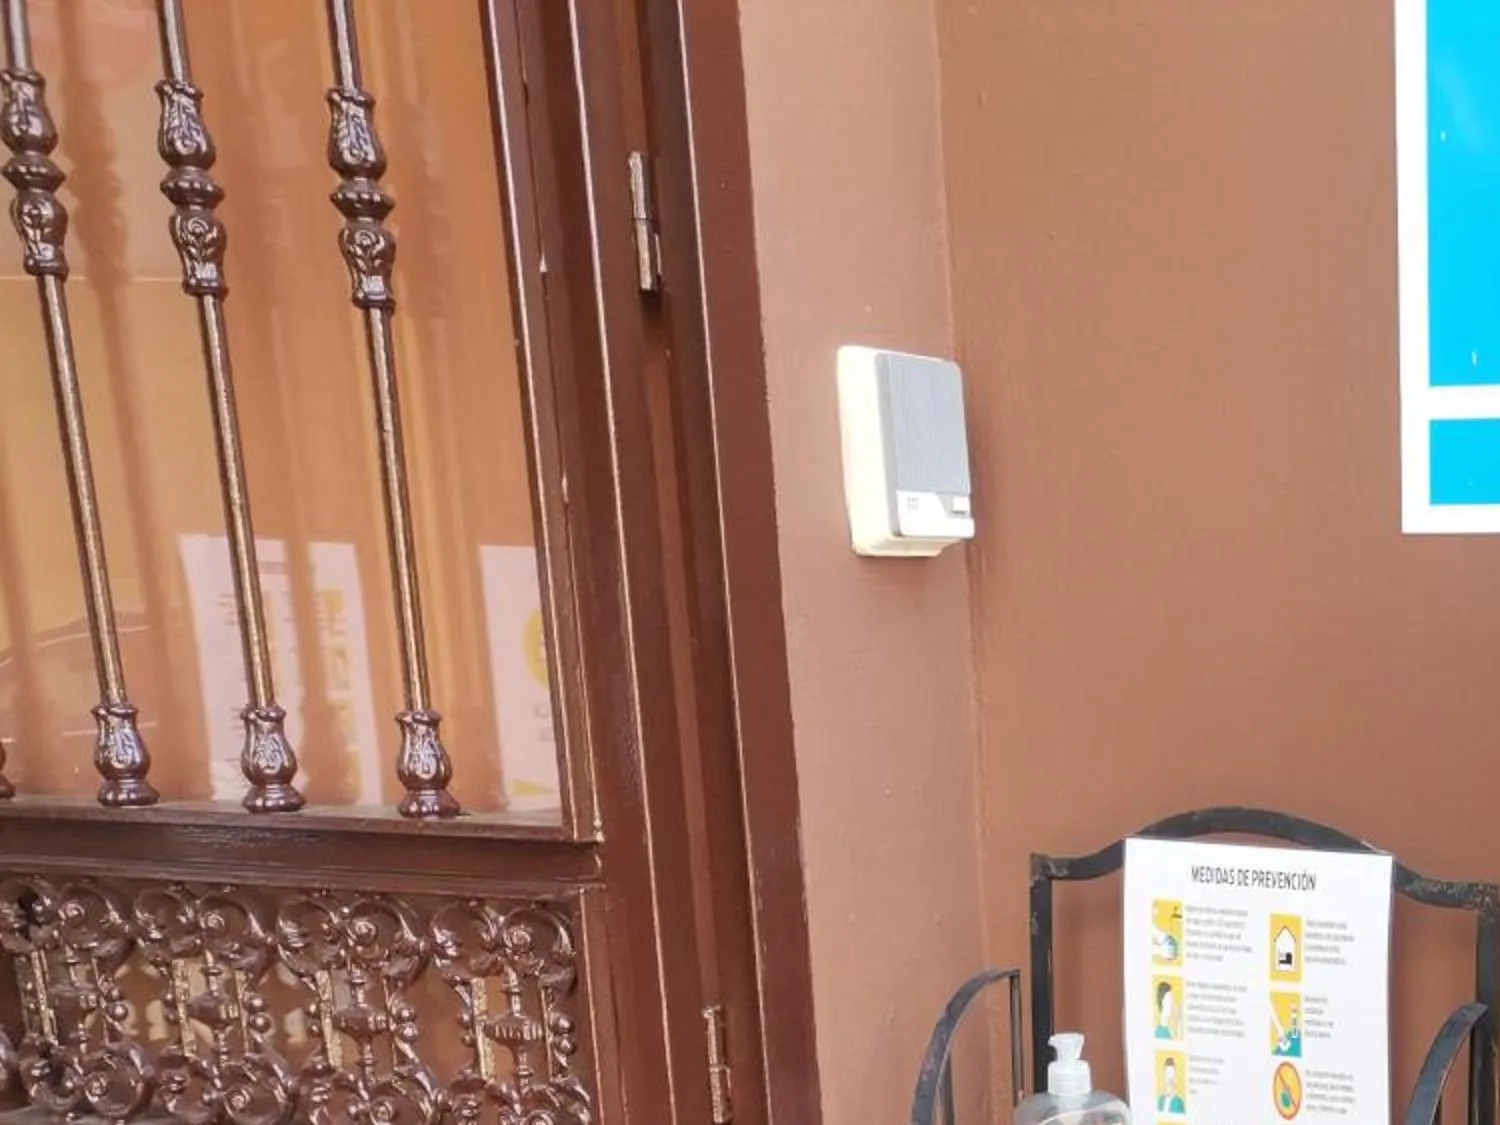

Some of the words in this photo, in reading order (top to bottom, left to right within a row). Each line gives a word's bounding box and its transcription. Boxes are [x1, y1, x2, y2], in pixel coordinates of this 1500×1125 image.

[1191, 865, 1235, 886] MEDIDAS
[1238, 868, 1250, 887] DE
[1251, 870, 1317, 892] PREVENCIÓN
